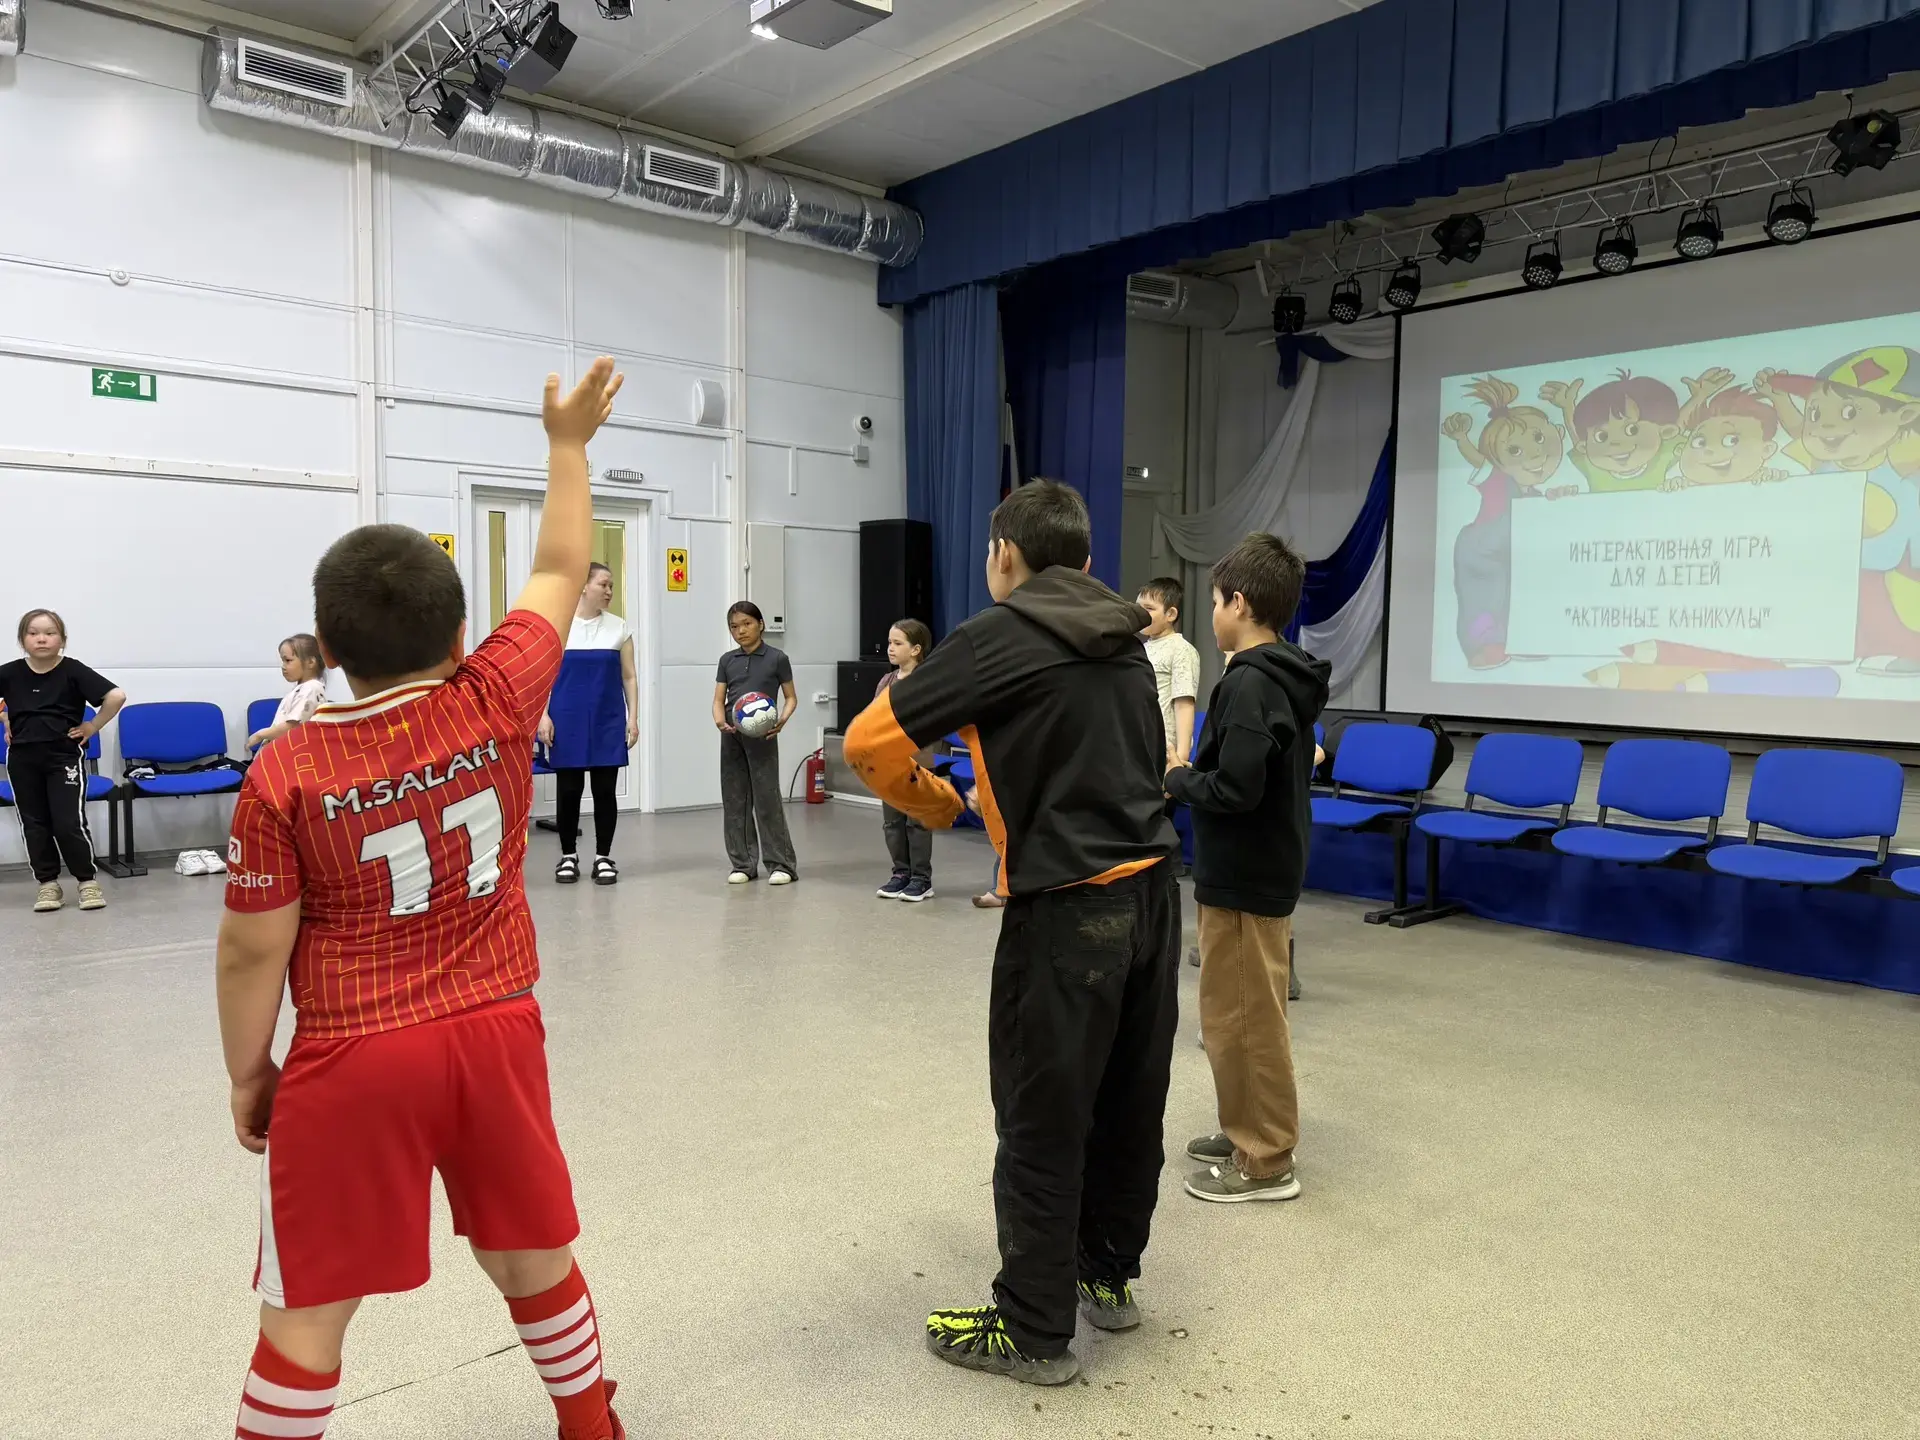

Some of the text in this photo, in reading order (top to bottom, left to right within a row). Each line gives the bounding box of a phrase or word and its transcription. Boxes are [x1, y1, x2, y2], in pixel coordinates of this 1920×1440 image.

[1569, 535, 1772, 563] ИНТЕРАКТИВНАЯ ИГРА
[1609, 560, 1720, 587] ДЛЯ ДЕТЕЙ
[1564, 605, 1771, 629] "АКТИВНЫЕ КАНИКУЛЫ"
[322, 737, 500, 822] M.SALAH
[359, 786, 504, 917] 11
